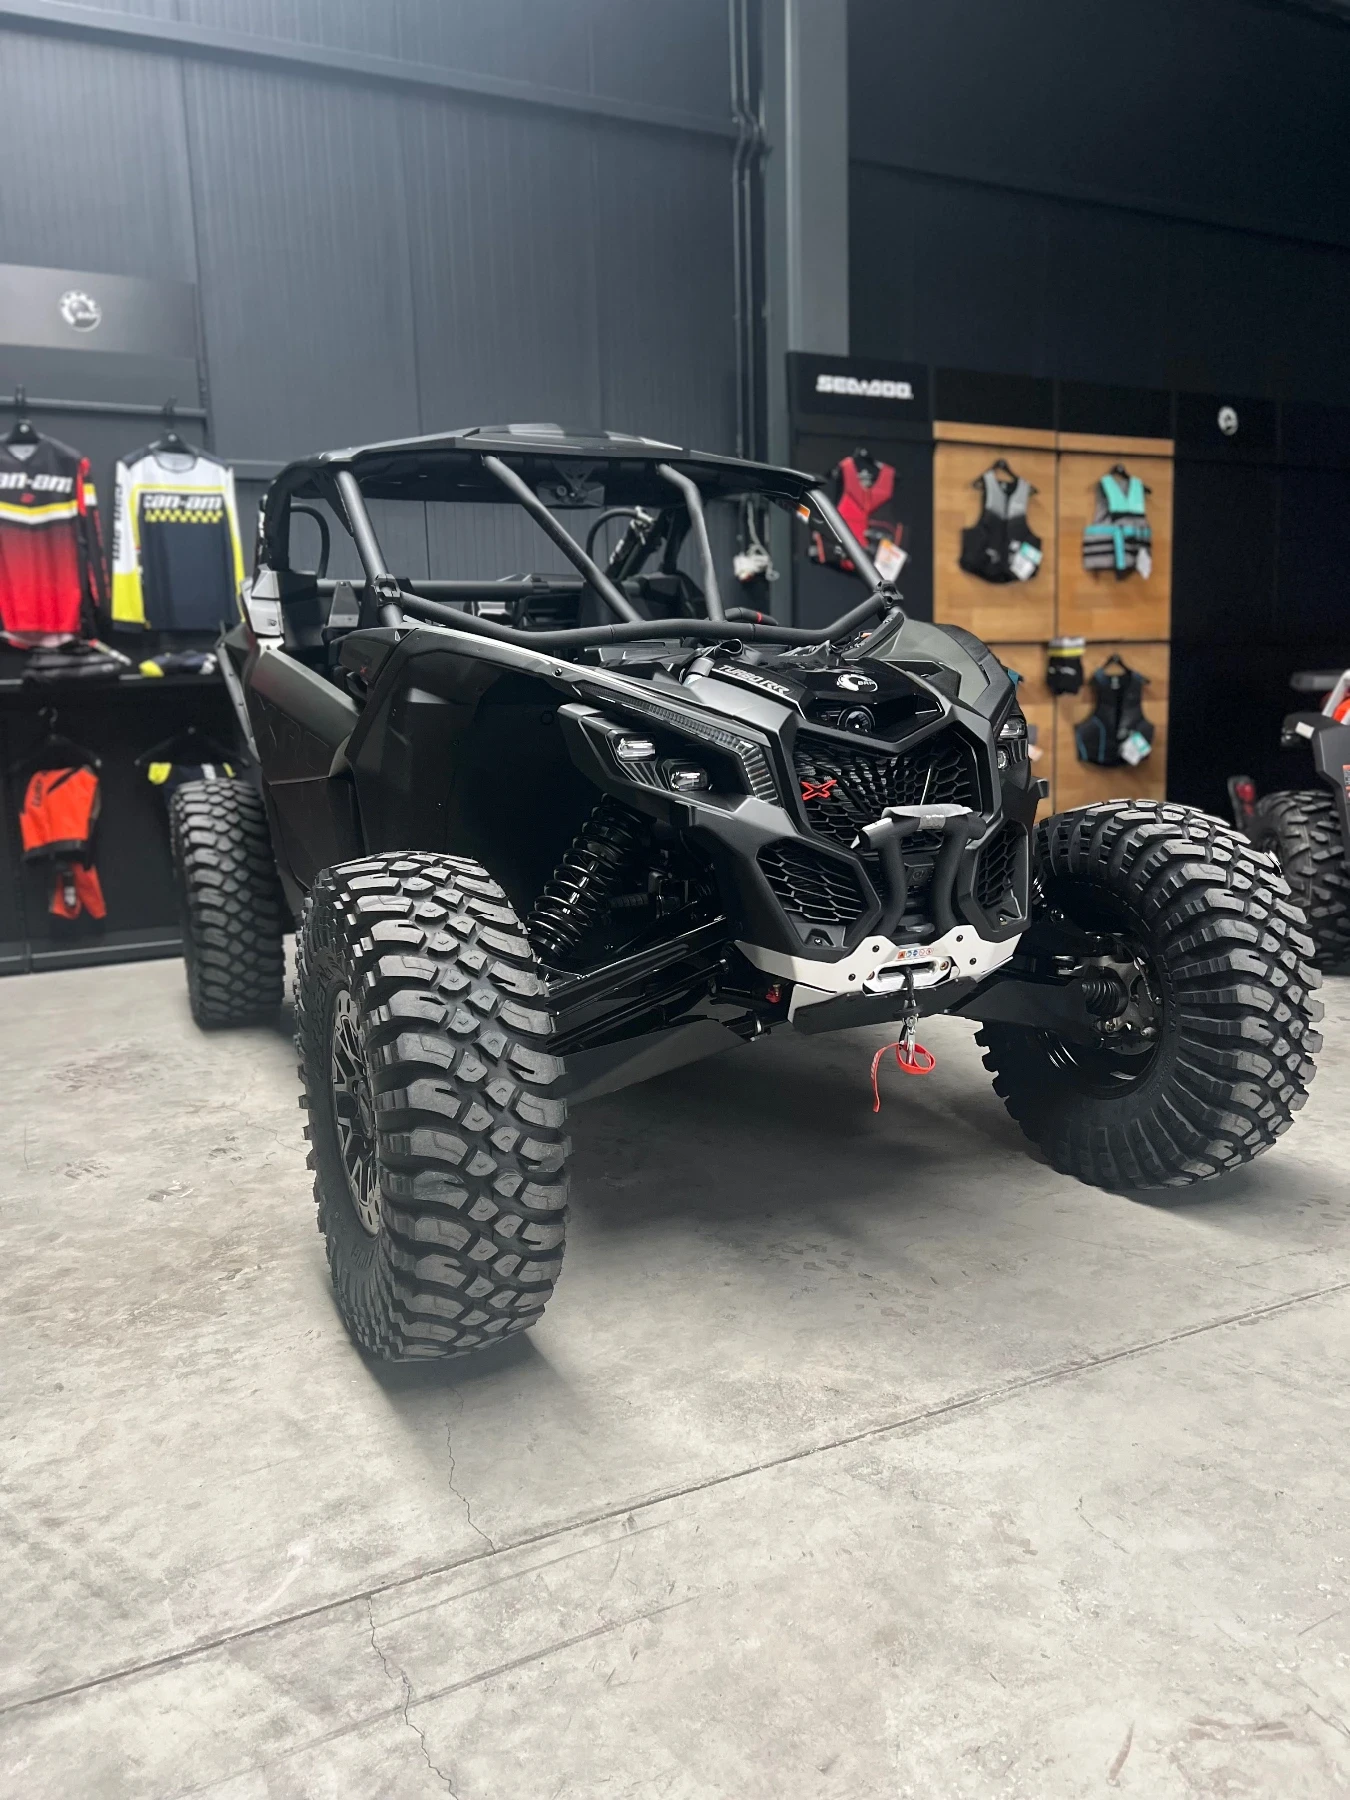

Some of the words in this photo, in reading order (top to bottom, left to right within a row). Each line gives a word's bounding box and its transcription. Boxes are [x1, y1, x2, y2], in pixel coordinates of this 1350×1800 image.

[143, 494, 222, 510] can-am
[718, 664, 762, 683] TURBO
[760, 679, 790, 695] RR
